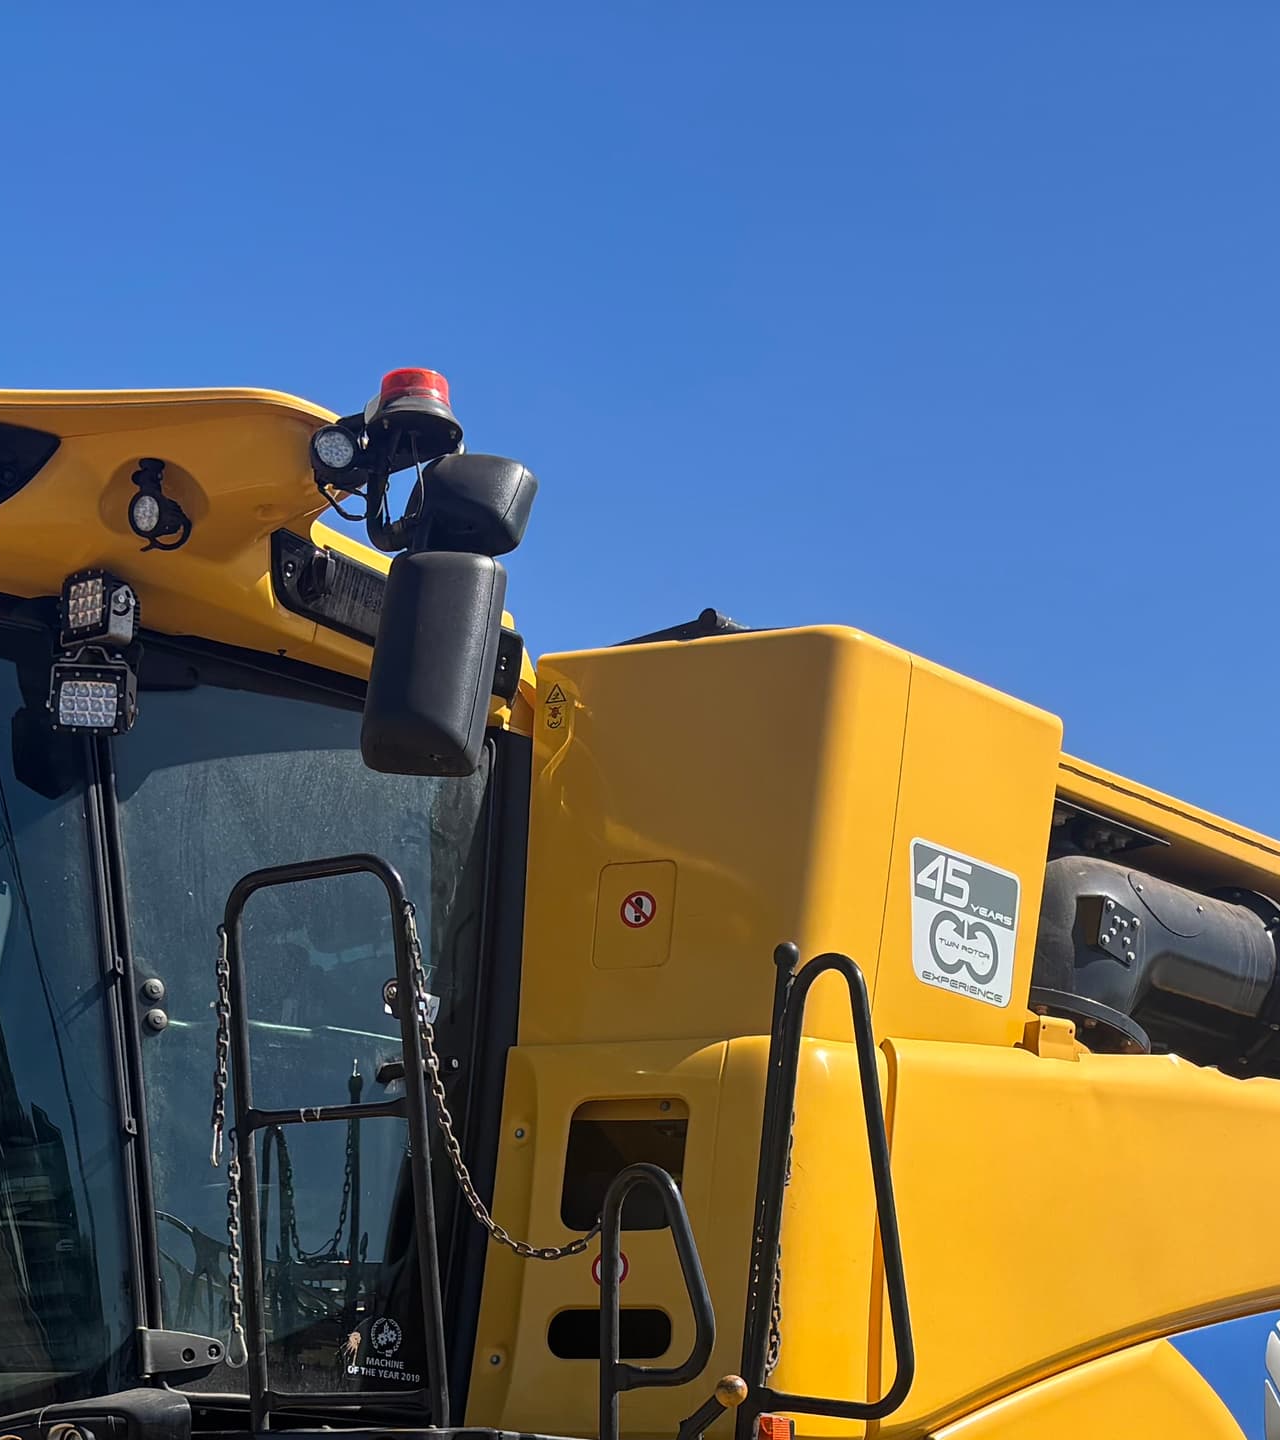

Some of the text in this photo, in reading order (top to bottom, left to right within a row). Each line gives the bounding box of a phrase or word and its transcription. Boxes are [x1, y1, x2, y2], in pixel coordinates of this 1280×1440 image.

[917, 855, 1012, 926] 45 YEARS
[938, 936, 990, 960] TWIN ROTOR
[922, 971, 1002, 1003] EXPERIENCE
[347, 1365, 420, 1382] OF THE YEAR 2019
[366, 1357, 404, 1369] MACHINE
